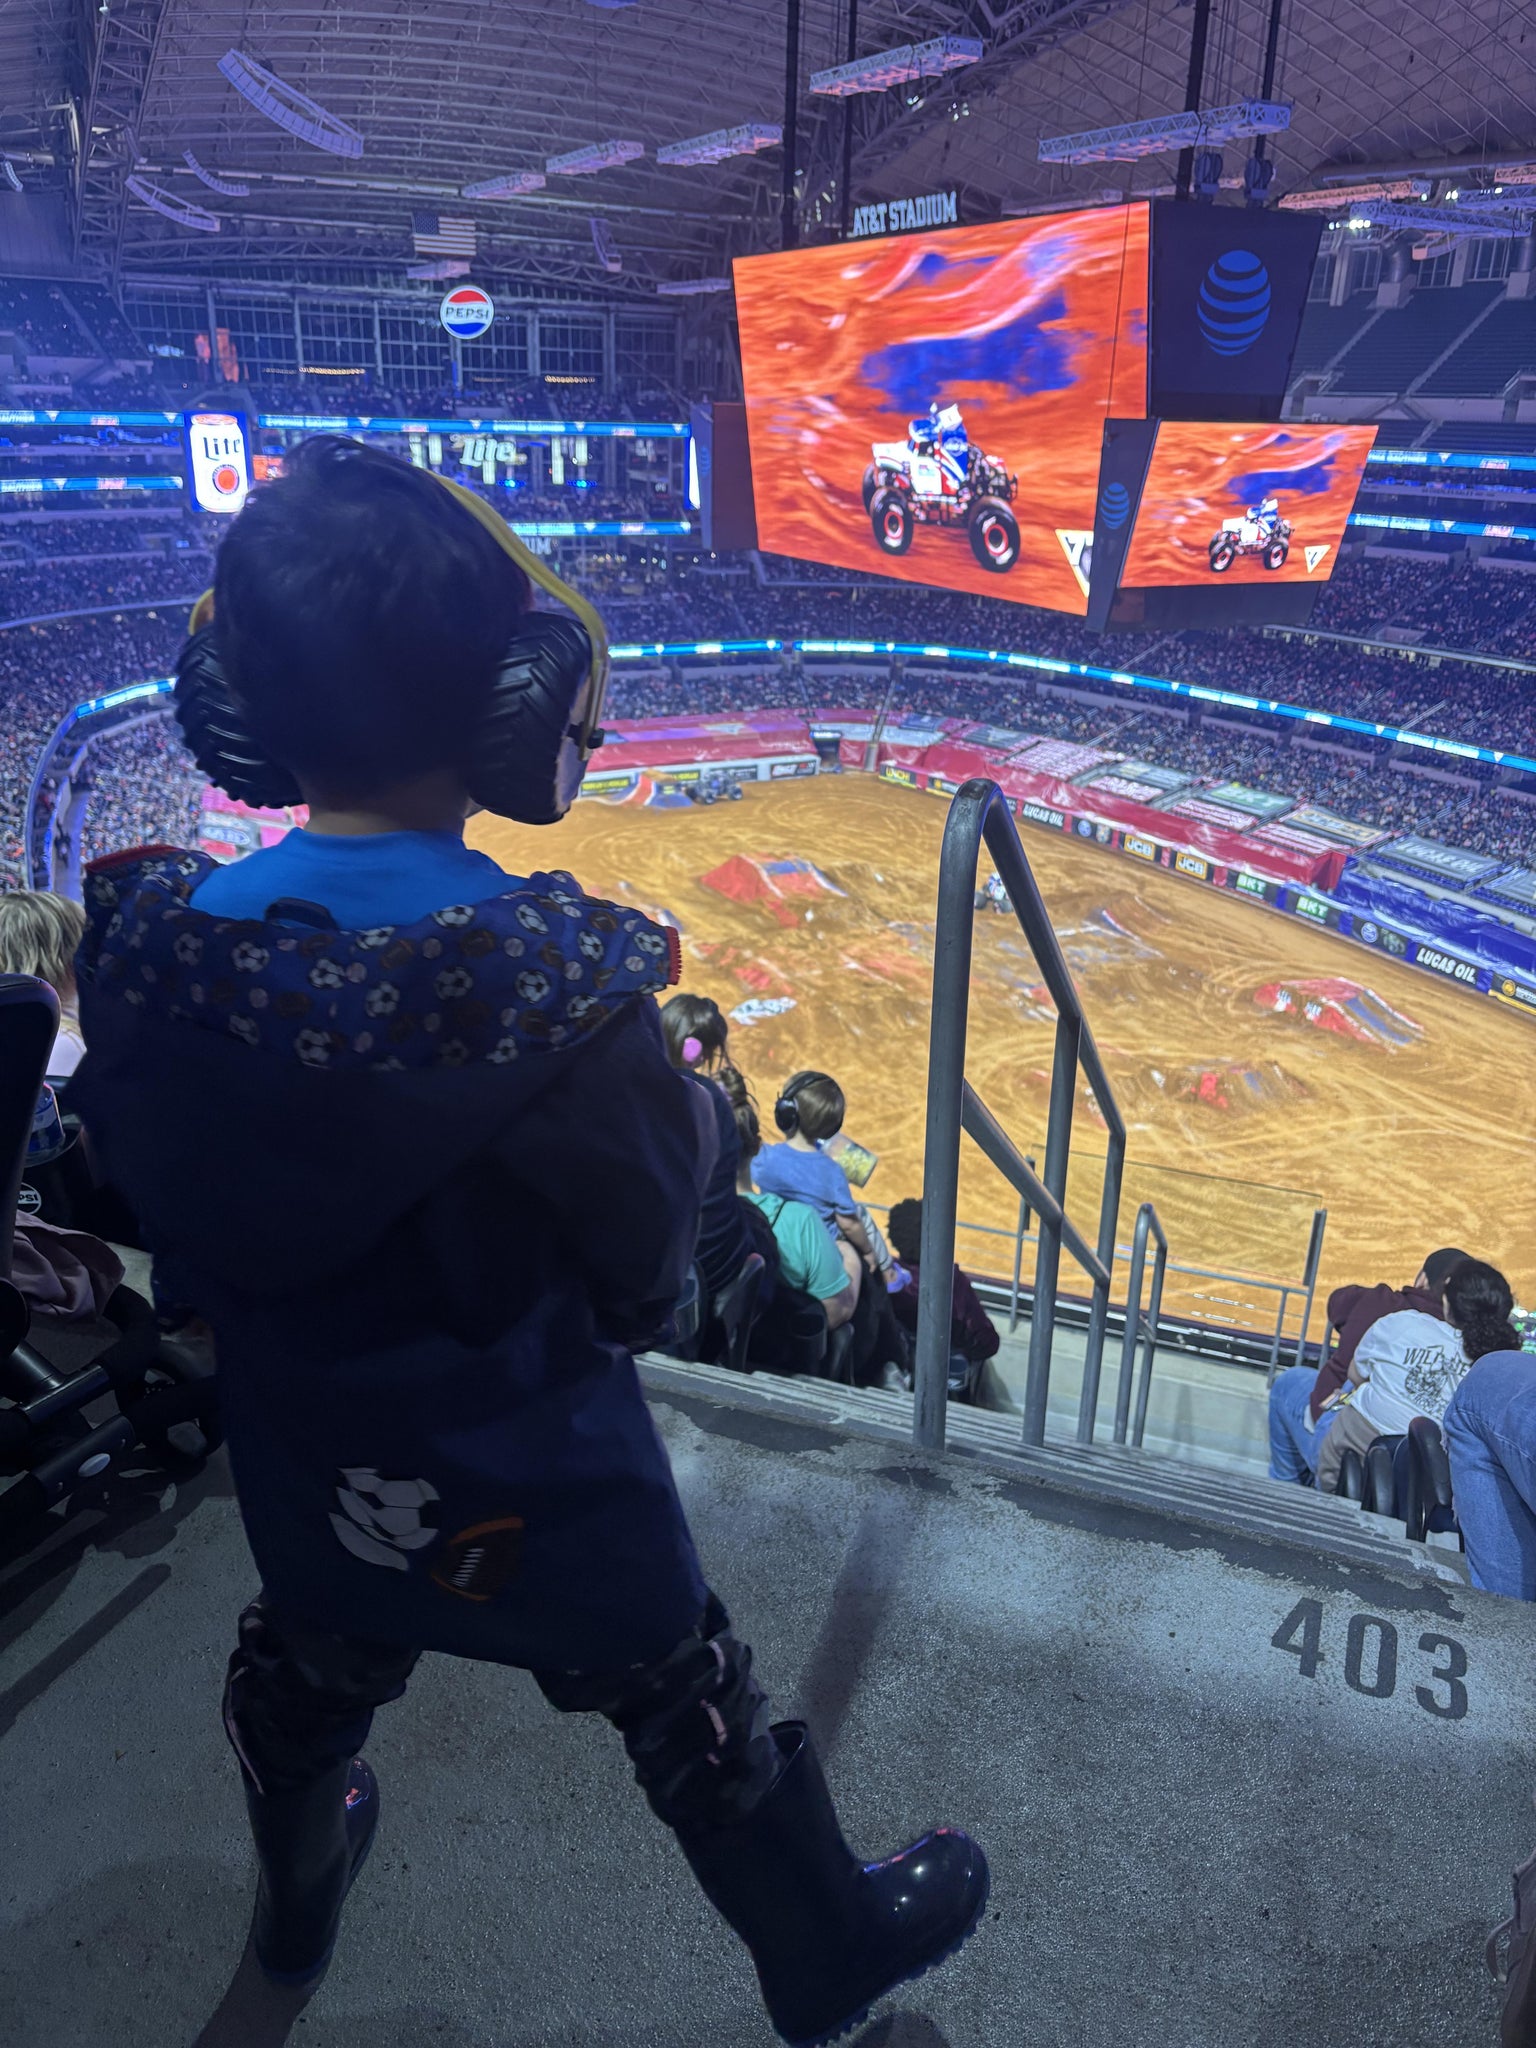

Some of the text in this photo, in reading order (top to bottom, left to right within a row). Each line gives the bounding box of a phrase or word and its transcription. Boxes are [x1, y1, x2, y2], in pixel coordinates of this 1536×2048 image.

[853, 191, 957, 237] AT&T STADIUM
[446, 306, 490, 319] PEPSI
[203, 437, 240, 461] Lite
[459, 438, 515, 467] Lite
[1127, 838, 1152, 857] JCB
[1178, 856, 1205, 876] JCB
[1238, 873, 1267, 894] BKT
[1298, 896, 1329, 918] BKT
[1416, 947, 1477, 985] LUCAS OIL
[1271, 1597, 1468, 1720] 403
